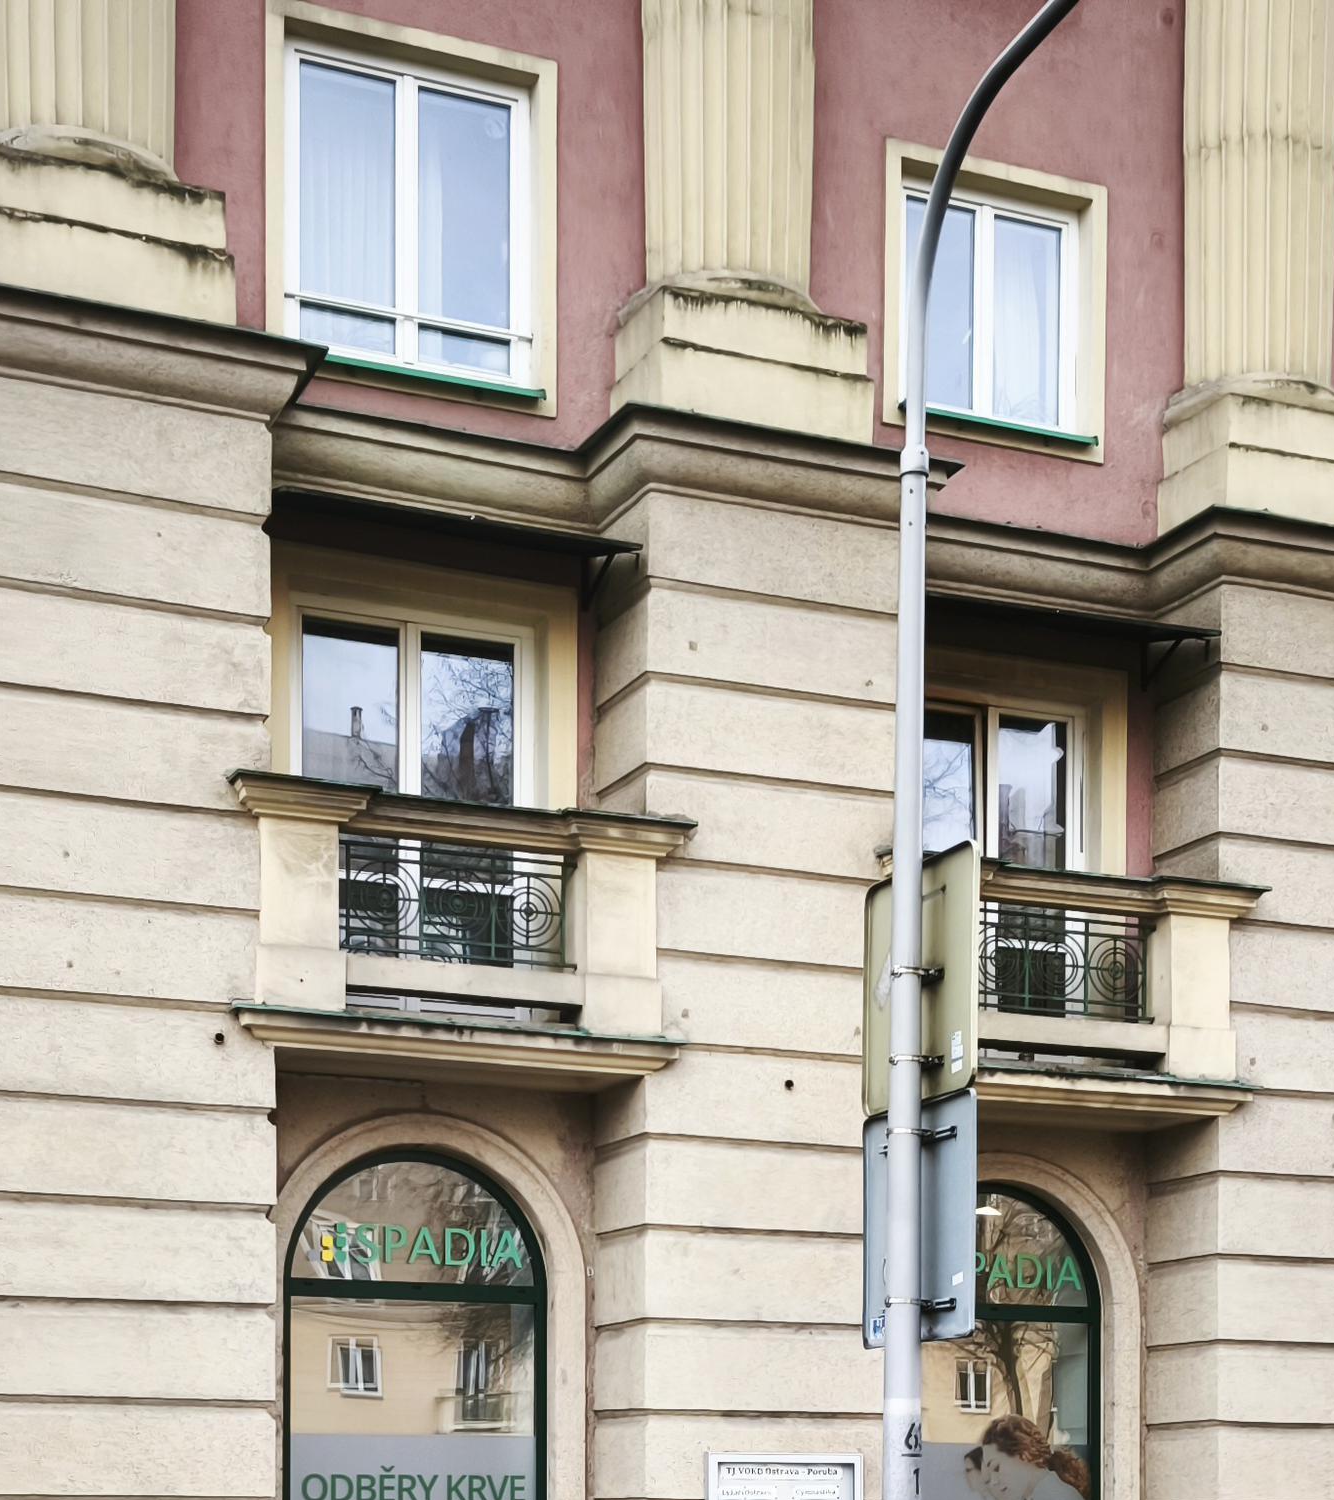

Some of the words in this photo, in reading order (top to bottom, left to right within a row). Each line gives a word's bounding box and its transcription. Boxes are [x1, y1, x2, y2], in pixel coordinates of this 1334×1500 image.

[353, 1222, 523, 1269] SPADIA
[726, 1467, 735, 1476] TJ
[765, 1467, 799, 1476] Ostrava
[807, 1468, 838, 1476] Poruba
